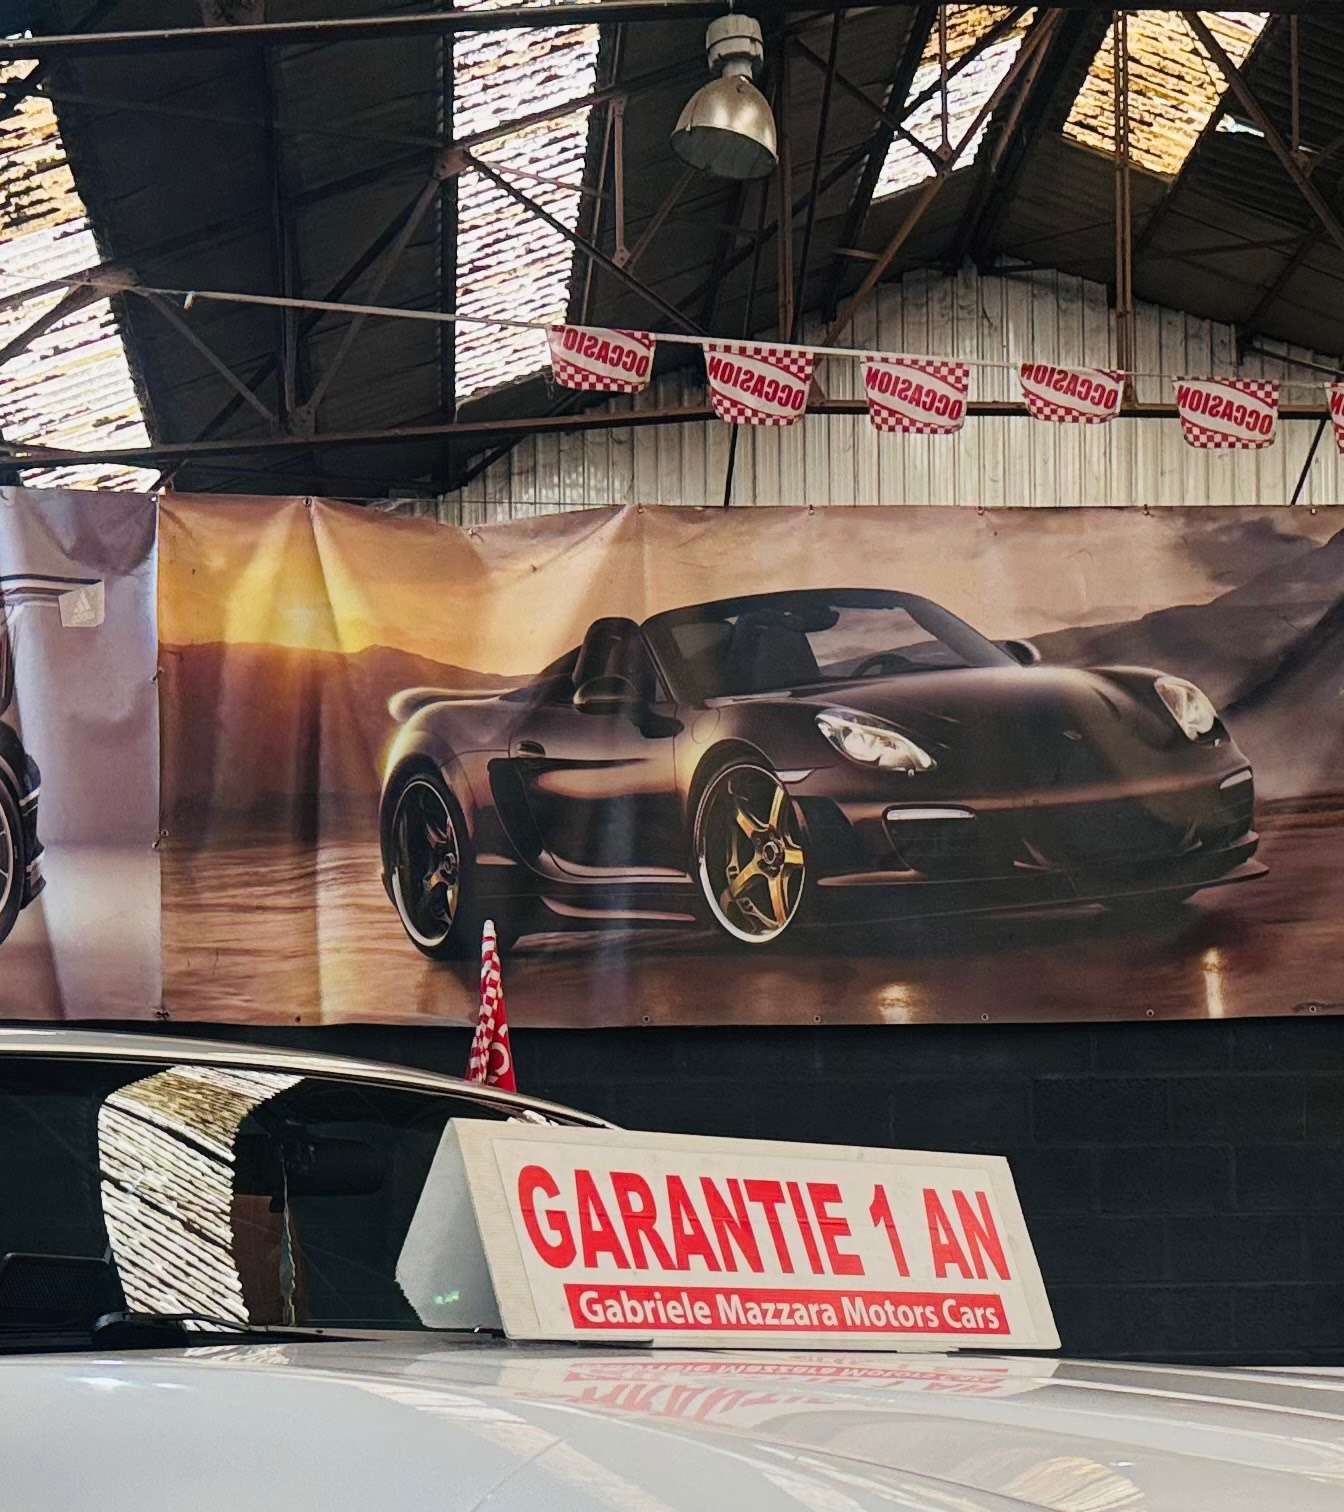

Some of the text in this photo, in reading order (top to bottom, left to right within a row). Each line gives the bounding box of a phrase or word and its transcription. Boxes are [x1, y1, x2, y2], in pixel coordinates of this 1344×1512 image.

[517, 1164, 1012, 1281] GARANTIE 1 AN
[578, 1289, 1001, 1331] Gabriele Mazzara Motors Cars
